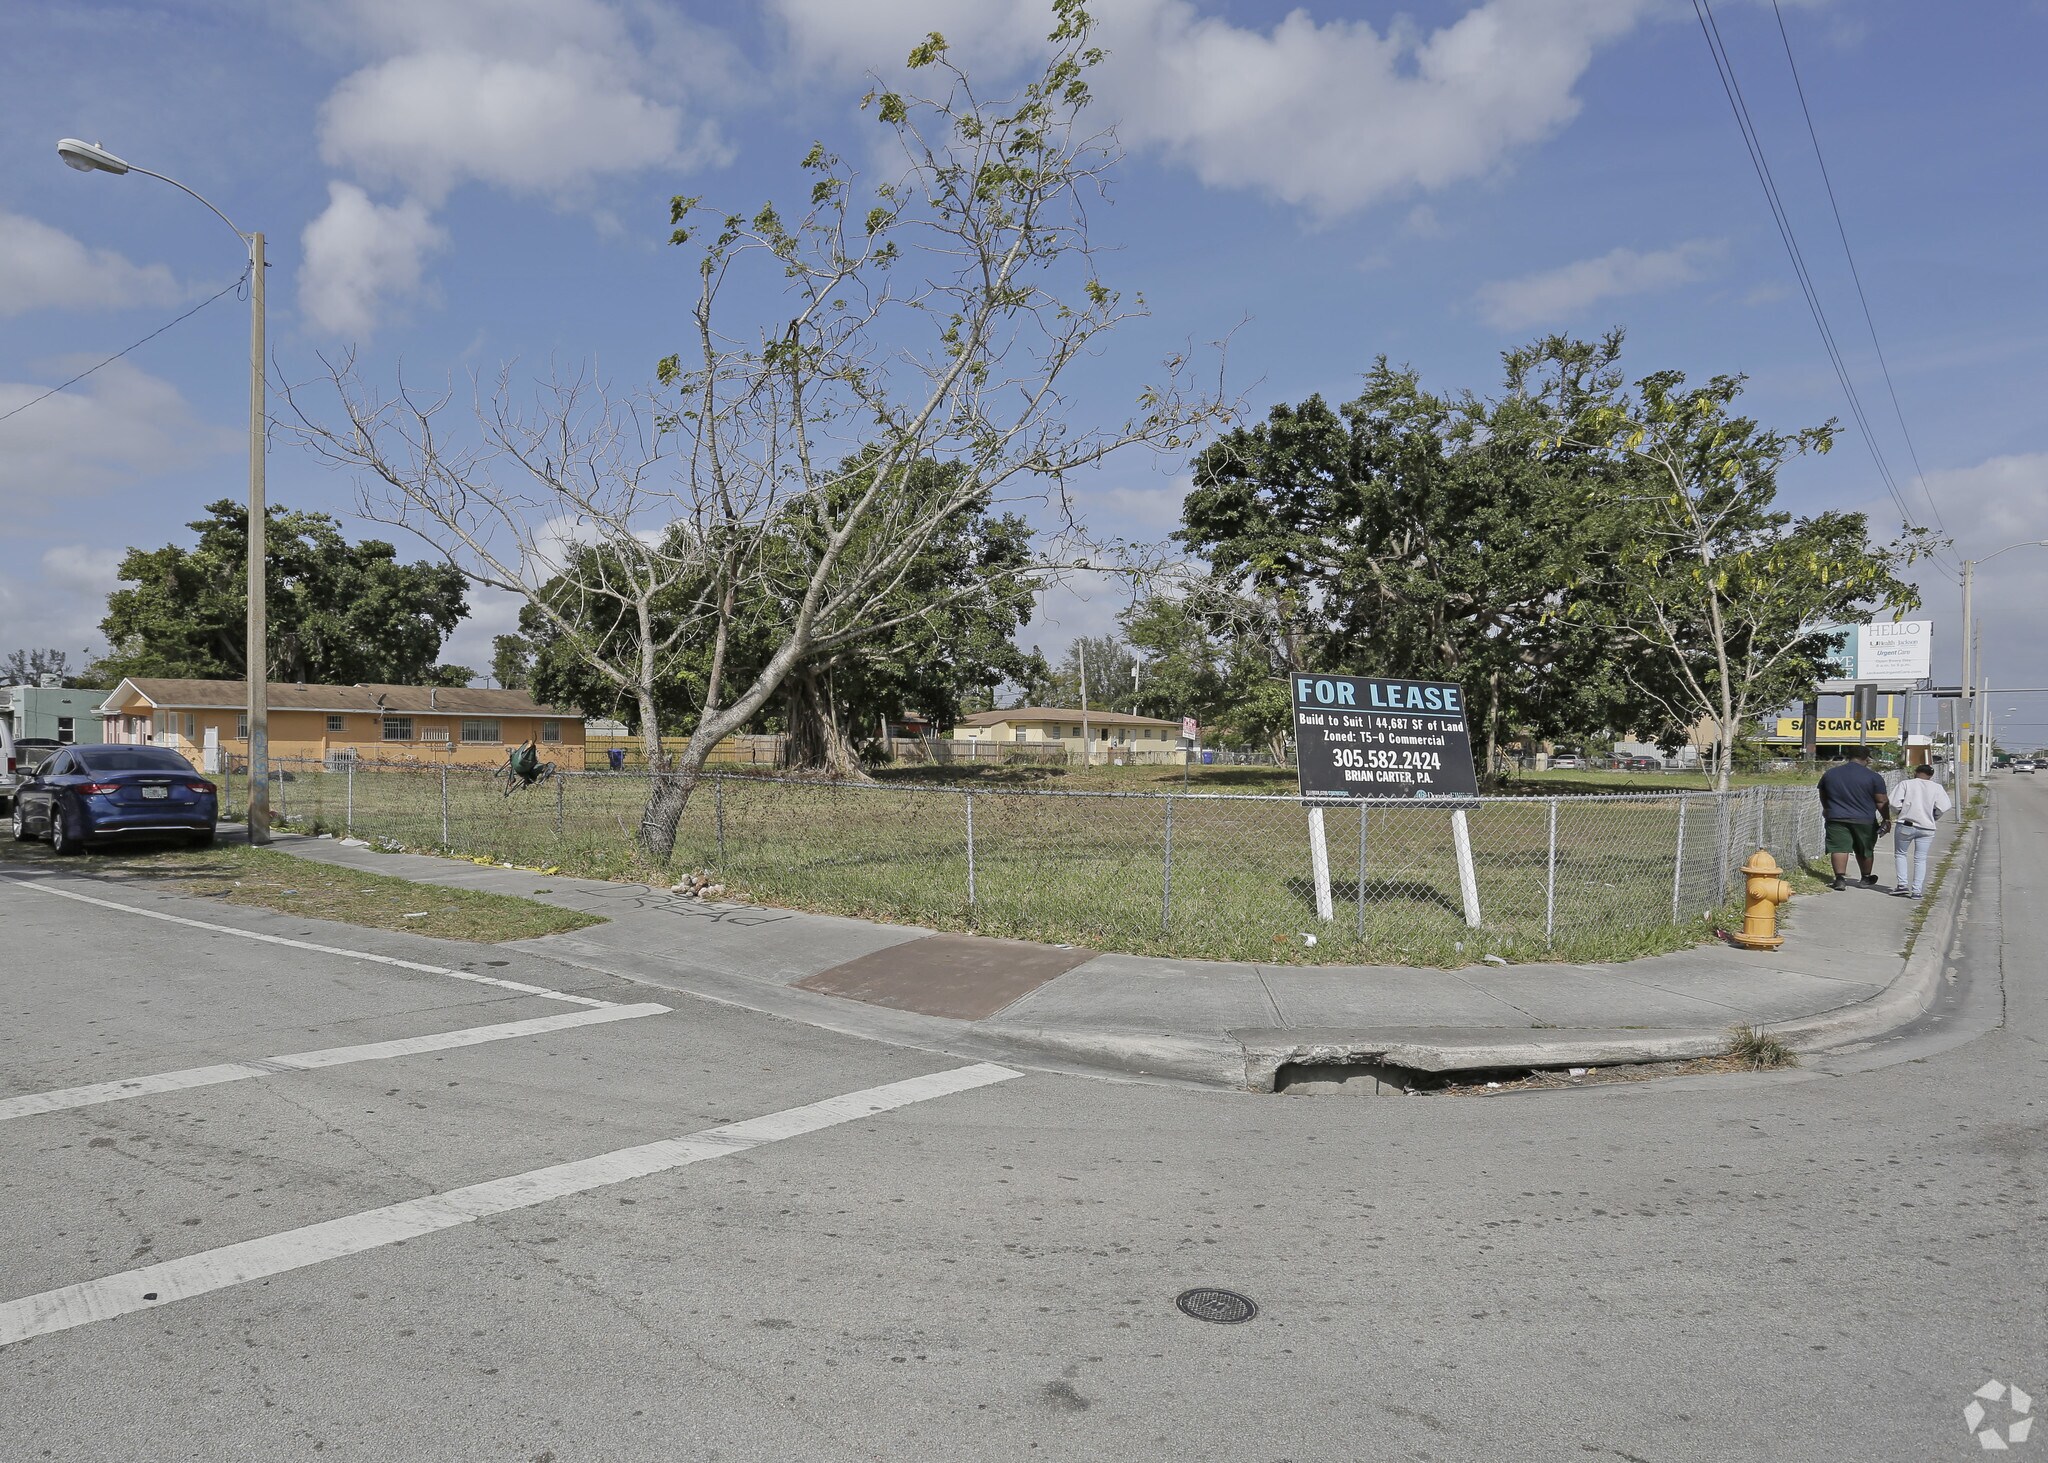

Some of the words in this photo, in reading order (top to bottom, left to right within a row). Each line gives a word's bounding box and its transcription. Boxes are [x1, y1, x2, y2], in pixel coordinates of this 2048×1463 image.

[1869, 623, 1920, 636] HELLO
[1297, 678, 1356, 705] FOR
[1370, 684, 1460, 711] LEASE
[1299, 713, 1324, 725] Build
[1329, 715, 1339, 726] to
[1343, 715, 1363, 728] Suit
[1376, 717, 1408, 730] 44,687
[1412, 719, 1423, 730] SF
[1428, 719, 1438, 731] of
[1442, 720, 1464, 732] Land
[1828, 720, 1851, 730] CAR
[1323, 730, 1356, 742] Zoned:
[1389, 733, 1445, 746] Commercial
[1333, 748, 1441, 770] 305.582.2424
[1345, 770, 1374, 782] BRIAN
[1376, 770, 1414, 785] CARTER,
[1417, 773, 1433, 784] P.A.
